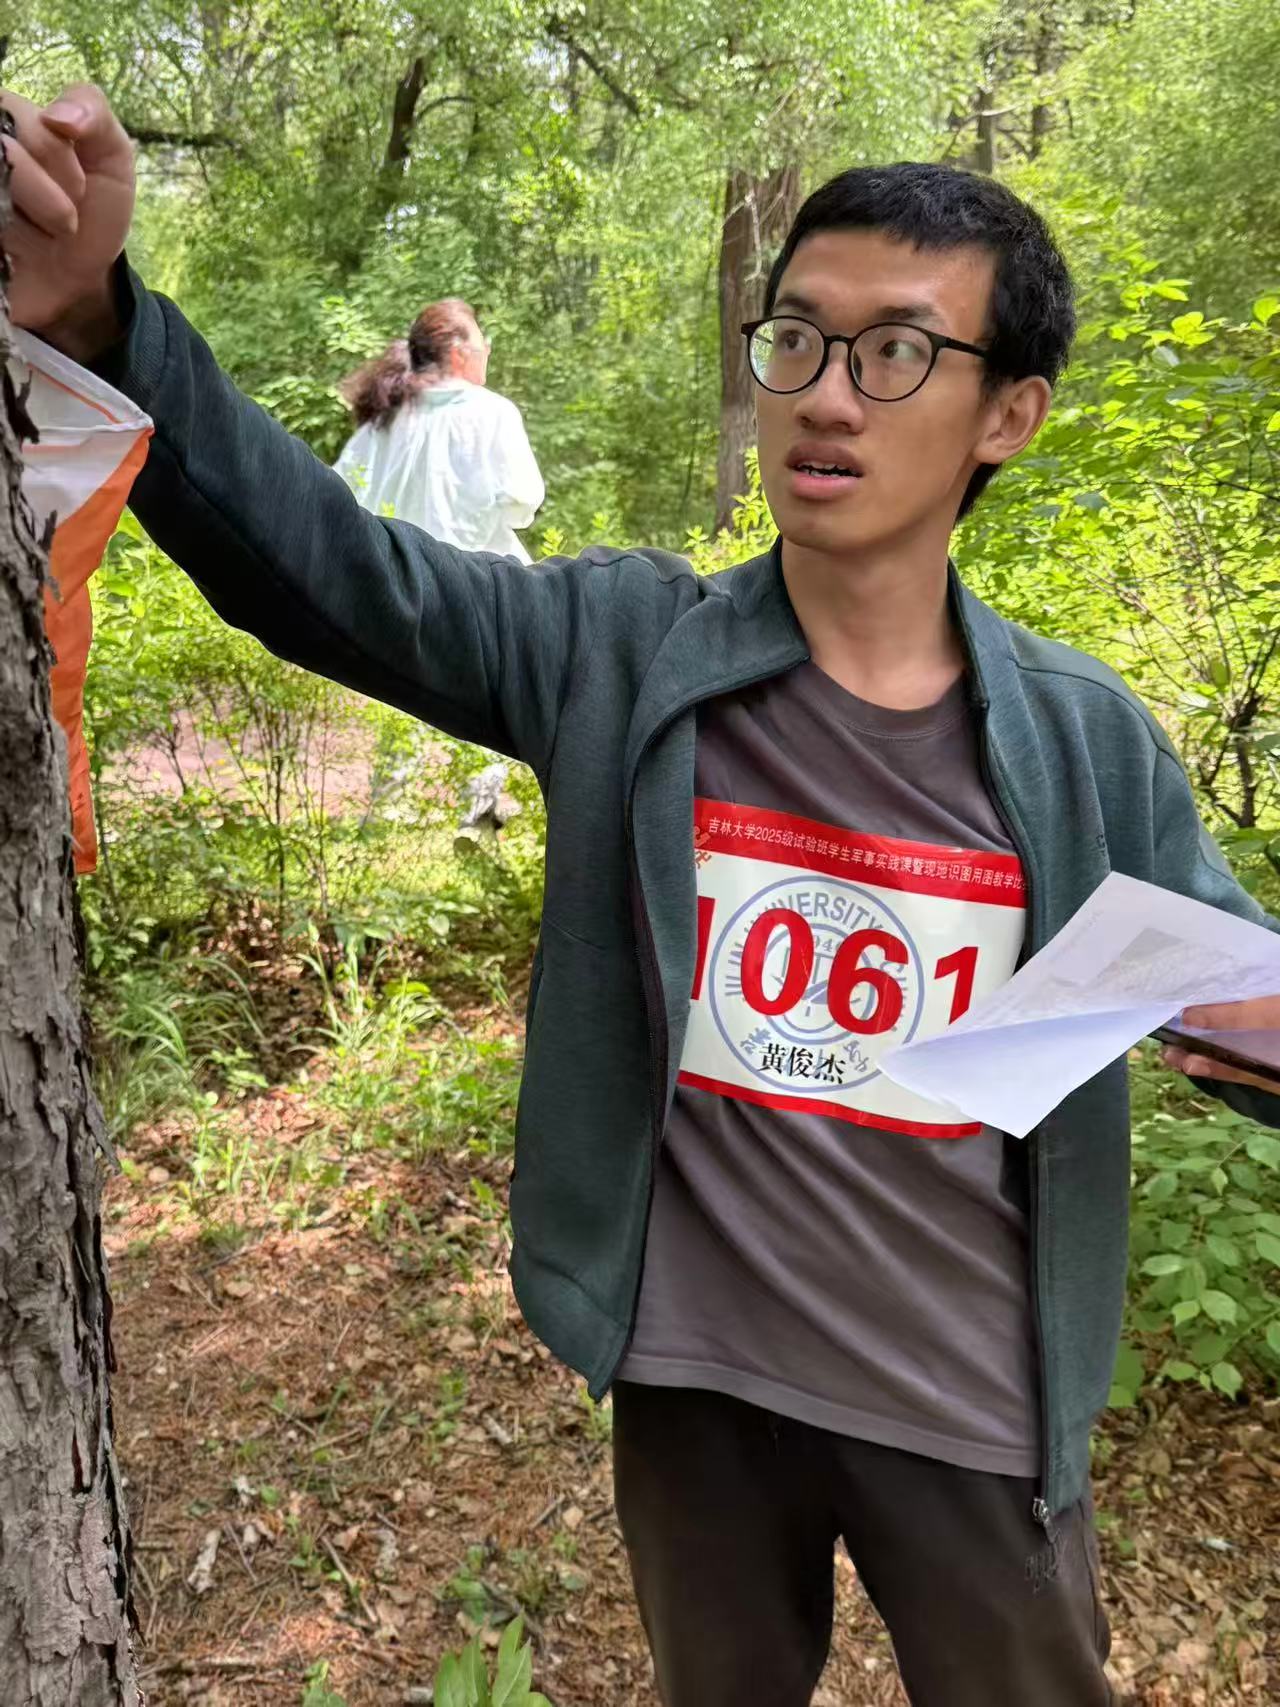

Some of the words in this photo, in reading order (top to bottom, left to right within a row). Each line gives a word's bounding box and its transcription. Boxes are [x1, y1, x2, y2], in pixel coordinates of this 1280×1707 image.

[708, 817, 1028, 891] 吉林大学2025级试验班学生军事实践课暨现地识图用图教学比
[758, 1043, 847, 1085] 黄俊杰
